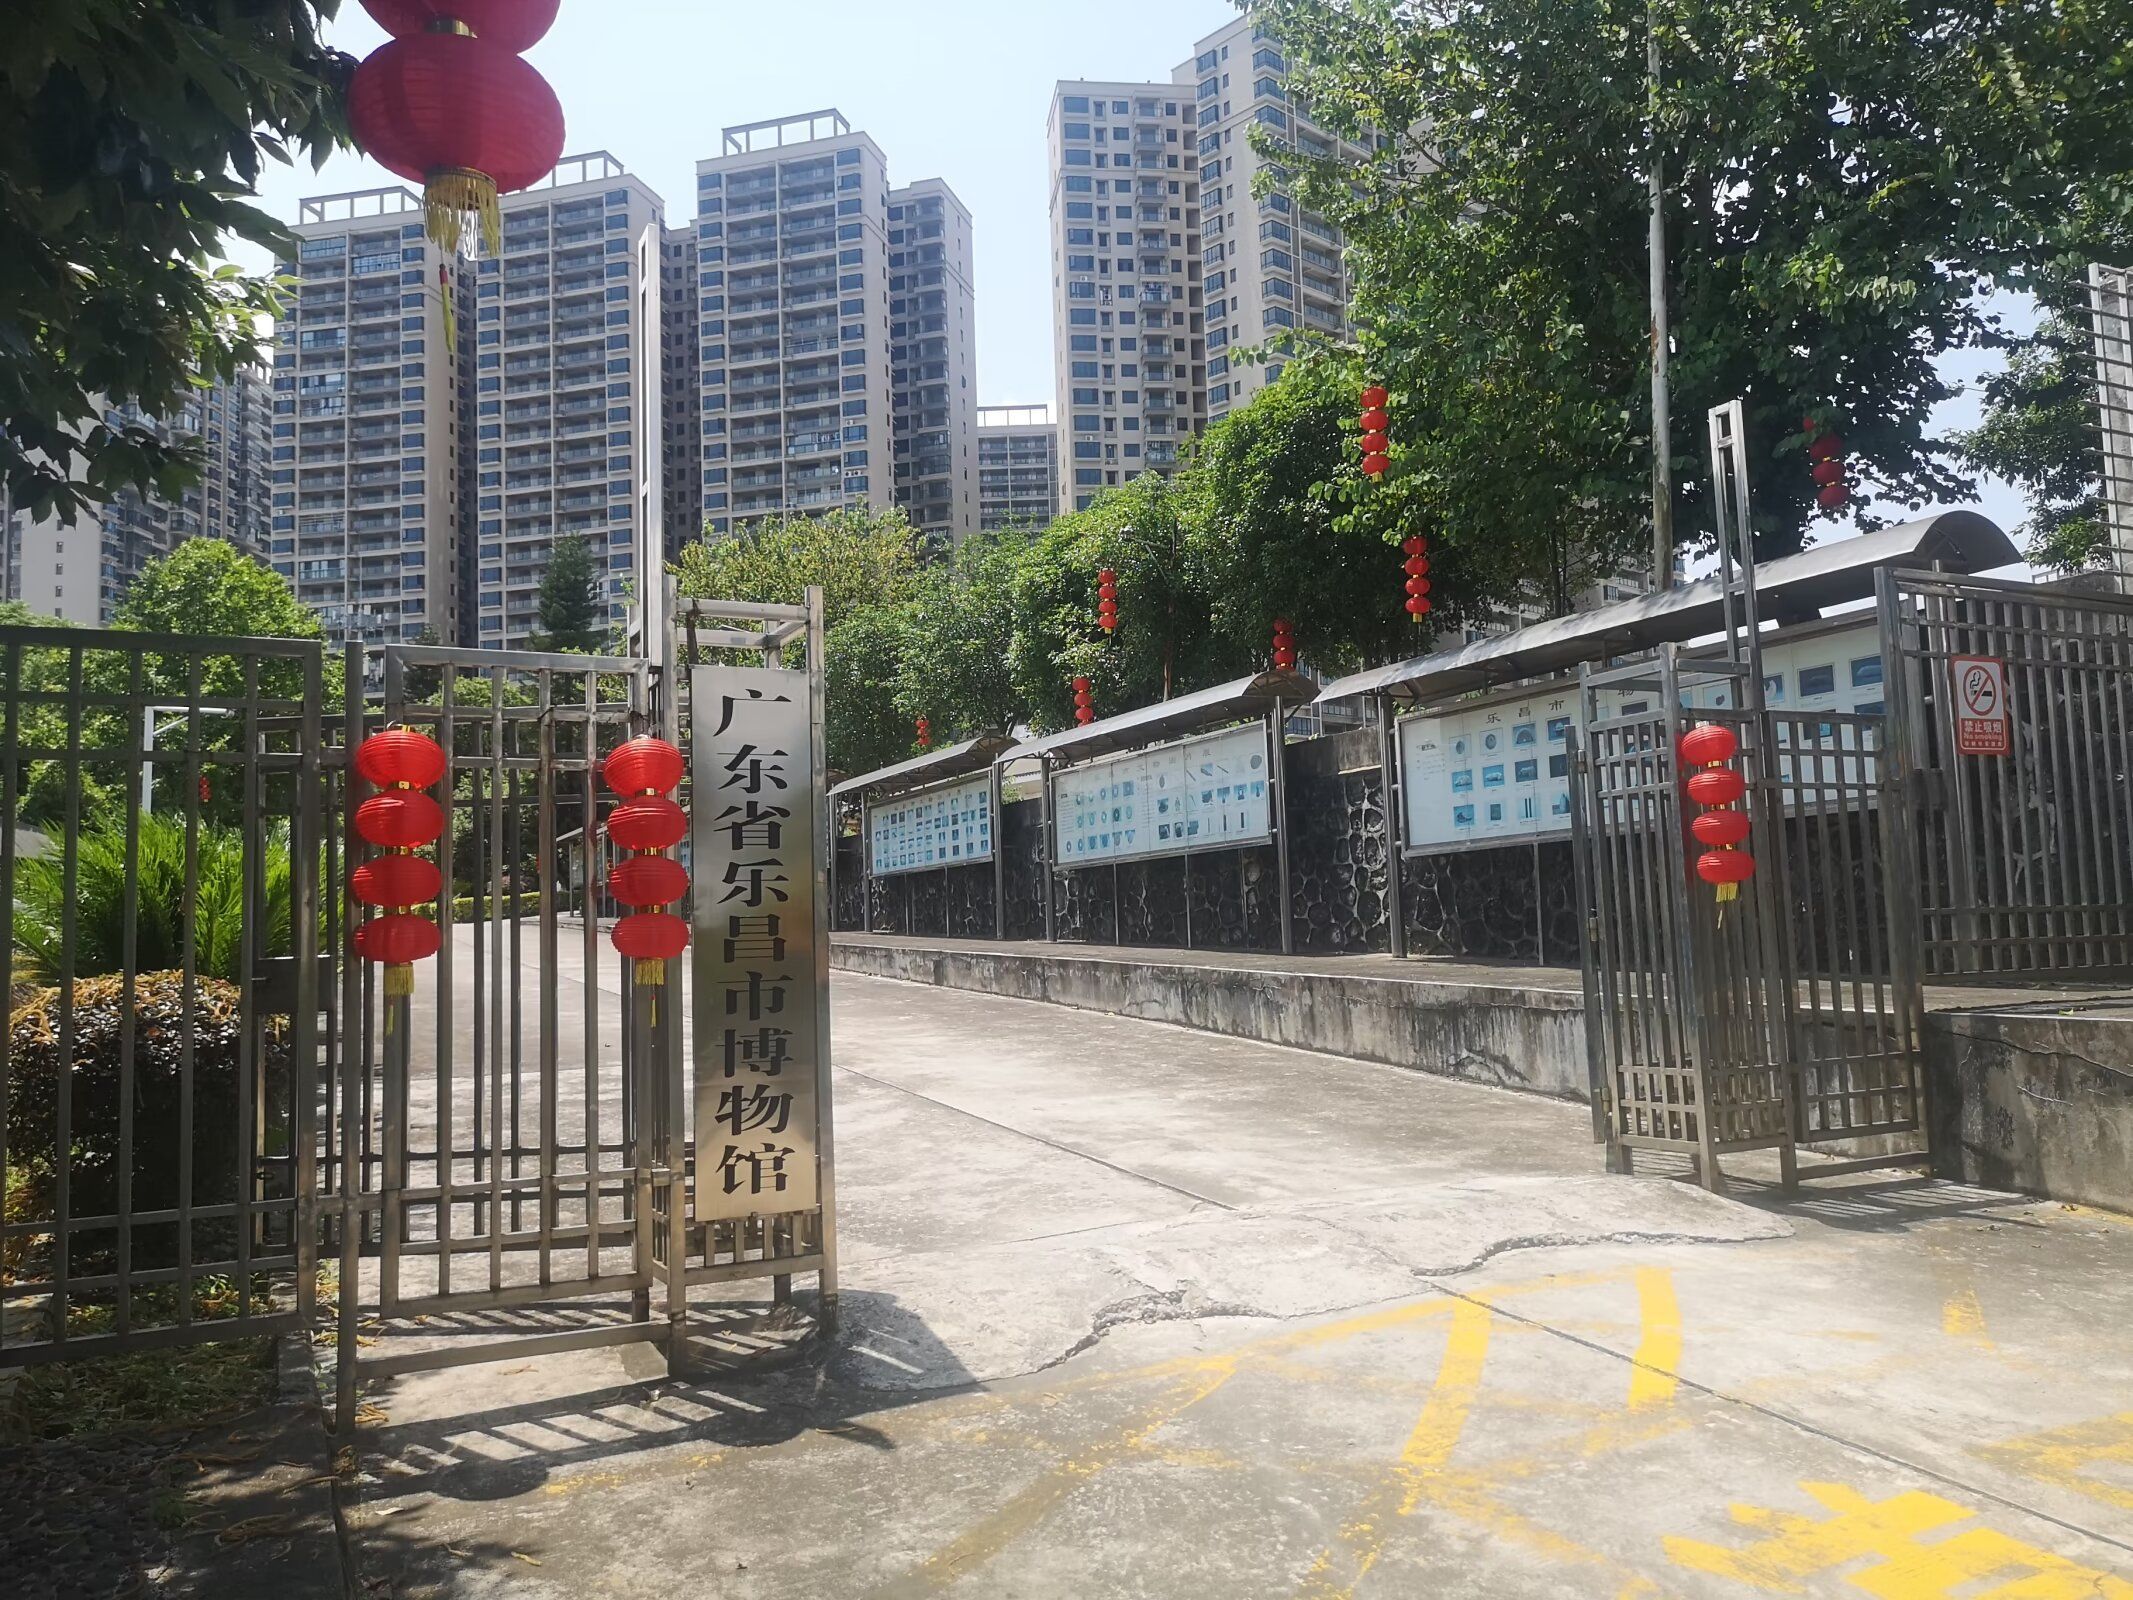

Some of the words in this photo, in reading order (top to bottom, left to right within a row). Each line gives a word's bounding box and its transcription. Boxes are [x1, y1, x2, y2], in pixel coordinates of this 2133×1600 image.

[1964, 721, 2002, 733] 禁止吸烟
[713, 688, 795, 1195] 广东省乐昌市博物馆
